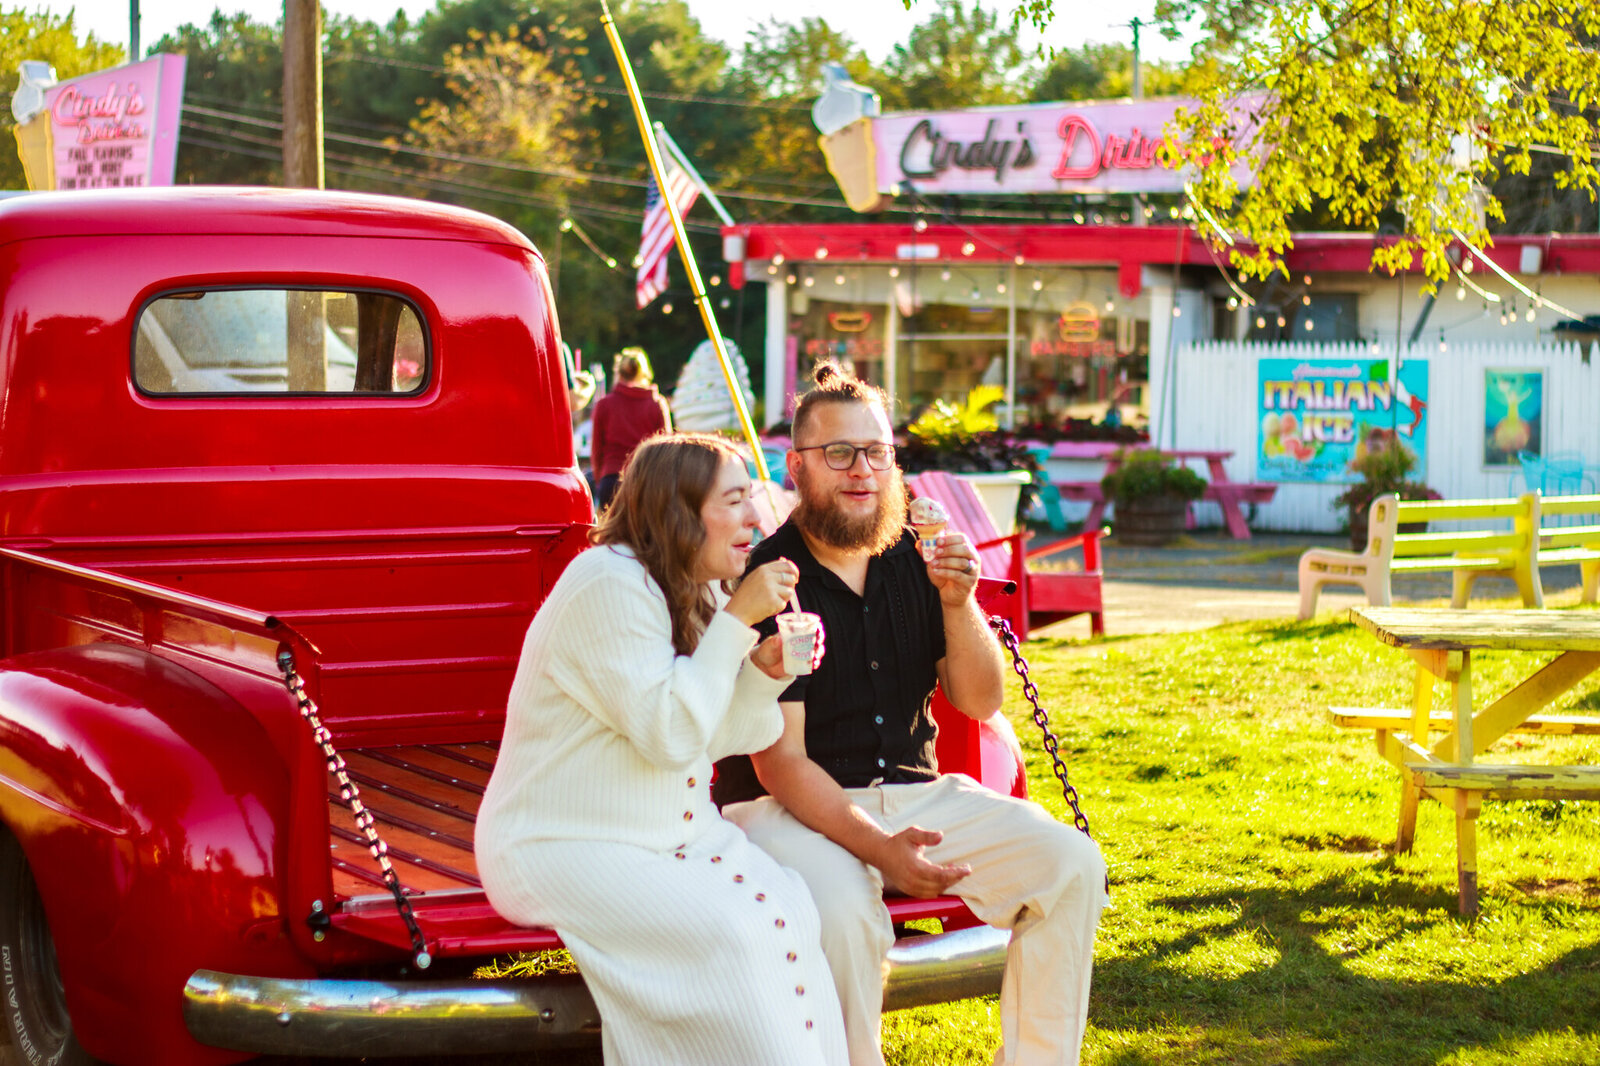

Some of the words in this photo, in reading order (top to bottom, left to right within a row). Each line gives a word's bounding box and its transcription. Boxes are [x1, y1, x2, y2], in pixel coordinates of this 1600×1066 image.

[52, 82, 145, 127] Cindy's
[901, 118, 1036, 182] Cindy's
[1263, 379, 1392, 411] ITALIAN
[1302, 414, 1355, 443] ICE
